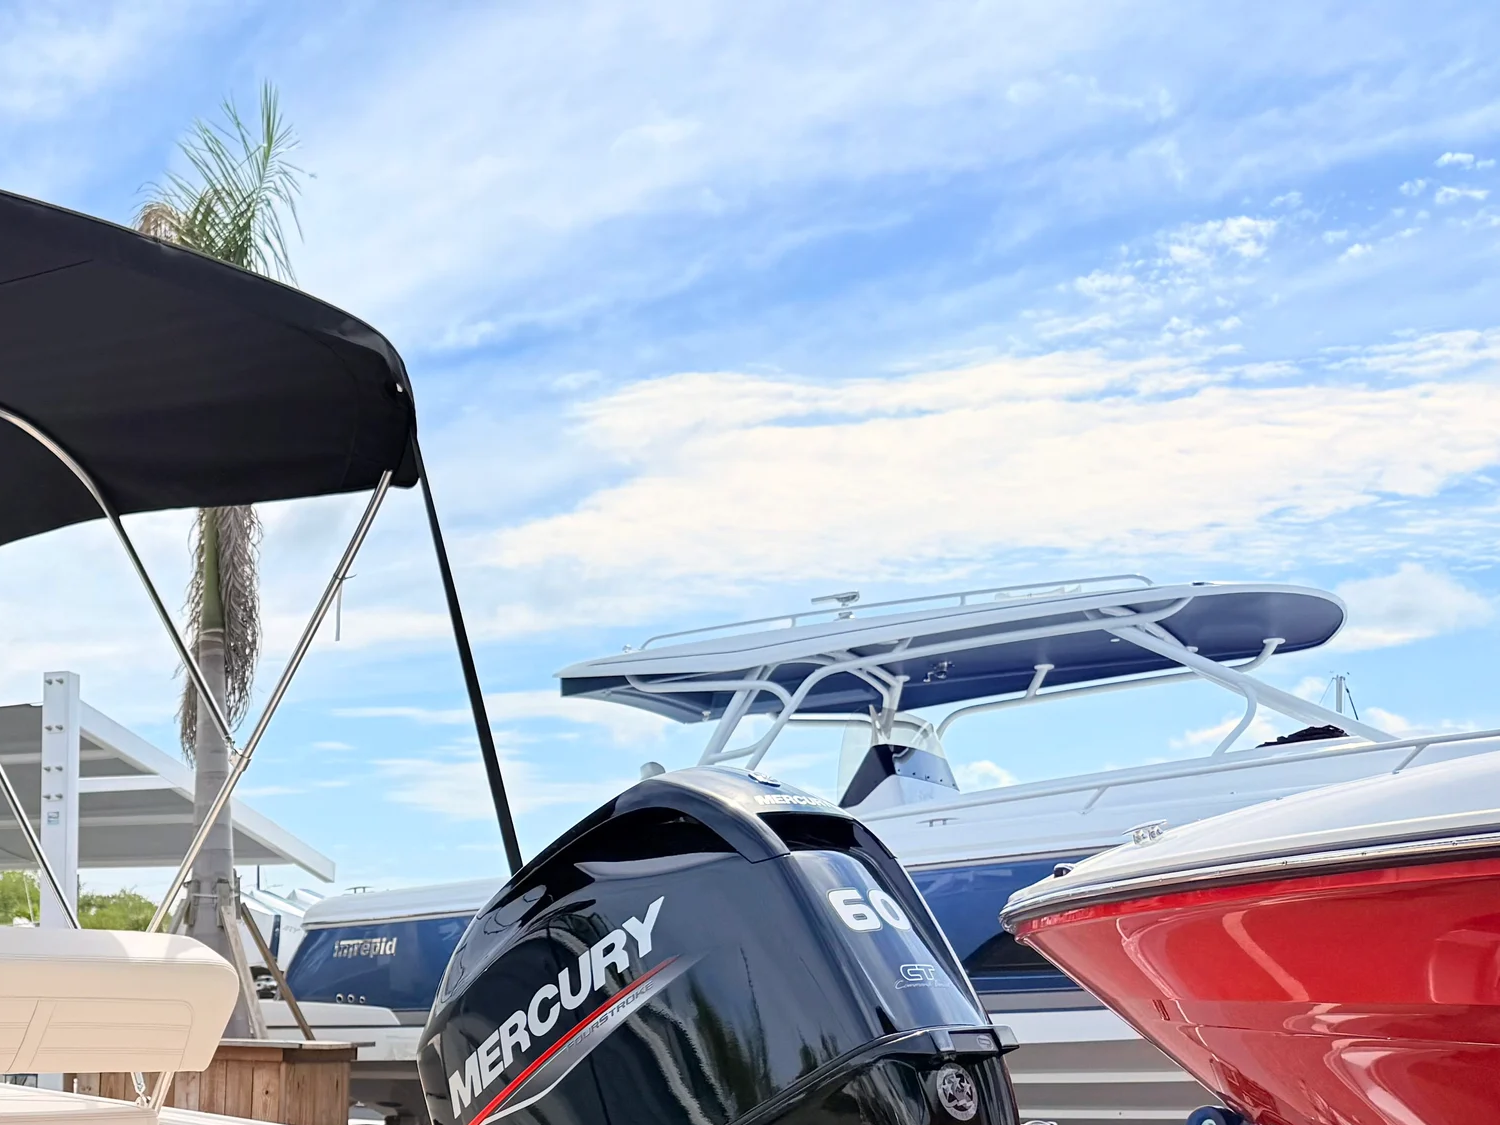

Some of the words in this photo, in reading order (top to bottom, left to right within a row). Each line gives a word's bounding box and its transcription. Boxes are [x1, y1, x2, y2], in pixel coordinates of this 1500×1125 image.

[827, 887, 912, 932] 60
[448, 896, 665, 1120] MERCURY
[566, 980, 654, 1052] FOURSTROKE
